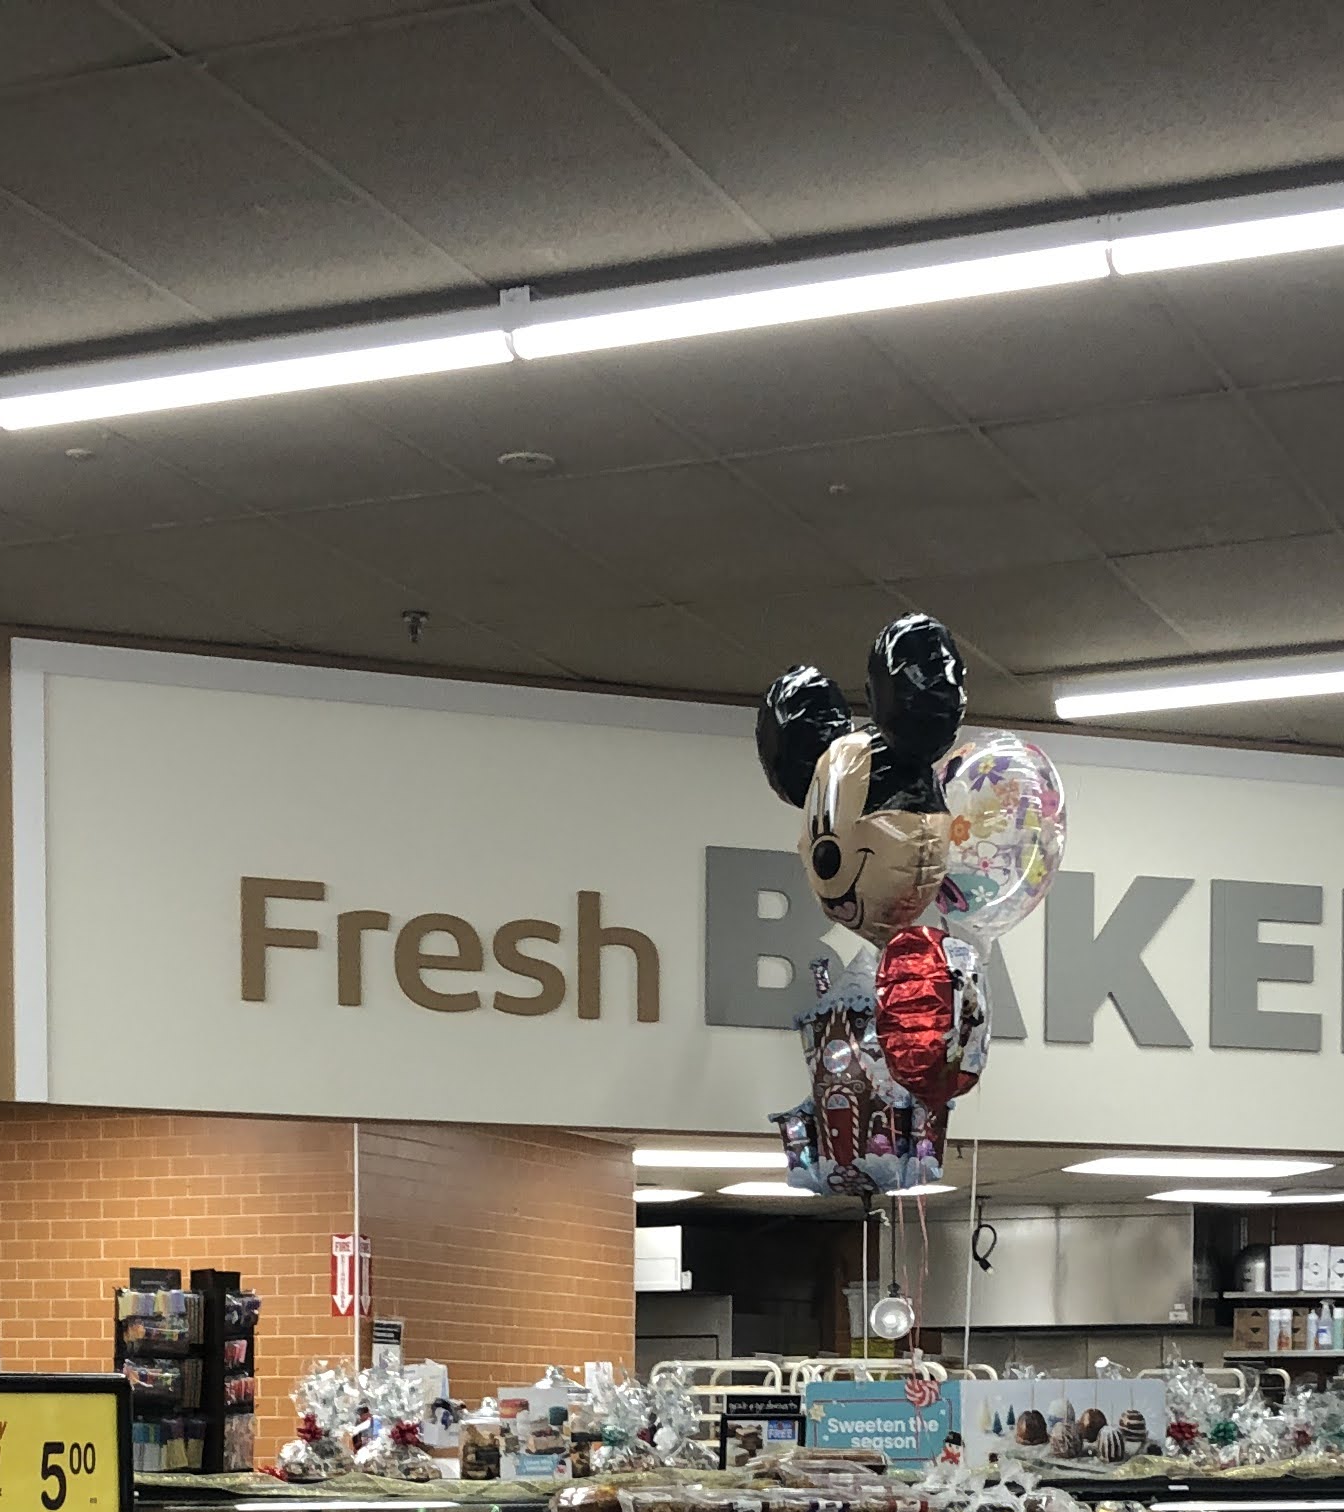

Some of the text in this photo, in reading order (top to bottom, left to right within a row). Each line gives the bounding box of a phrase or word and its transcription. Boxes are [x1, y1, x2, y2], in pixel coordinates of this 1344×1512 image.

[238, 874, 660, 1024] Fresh
[827, 1417, 940, 1433] Sweeten the
[850, 1434, 917, 1449] season
